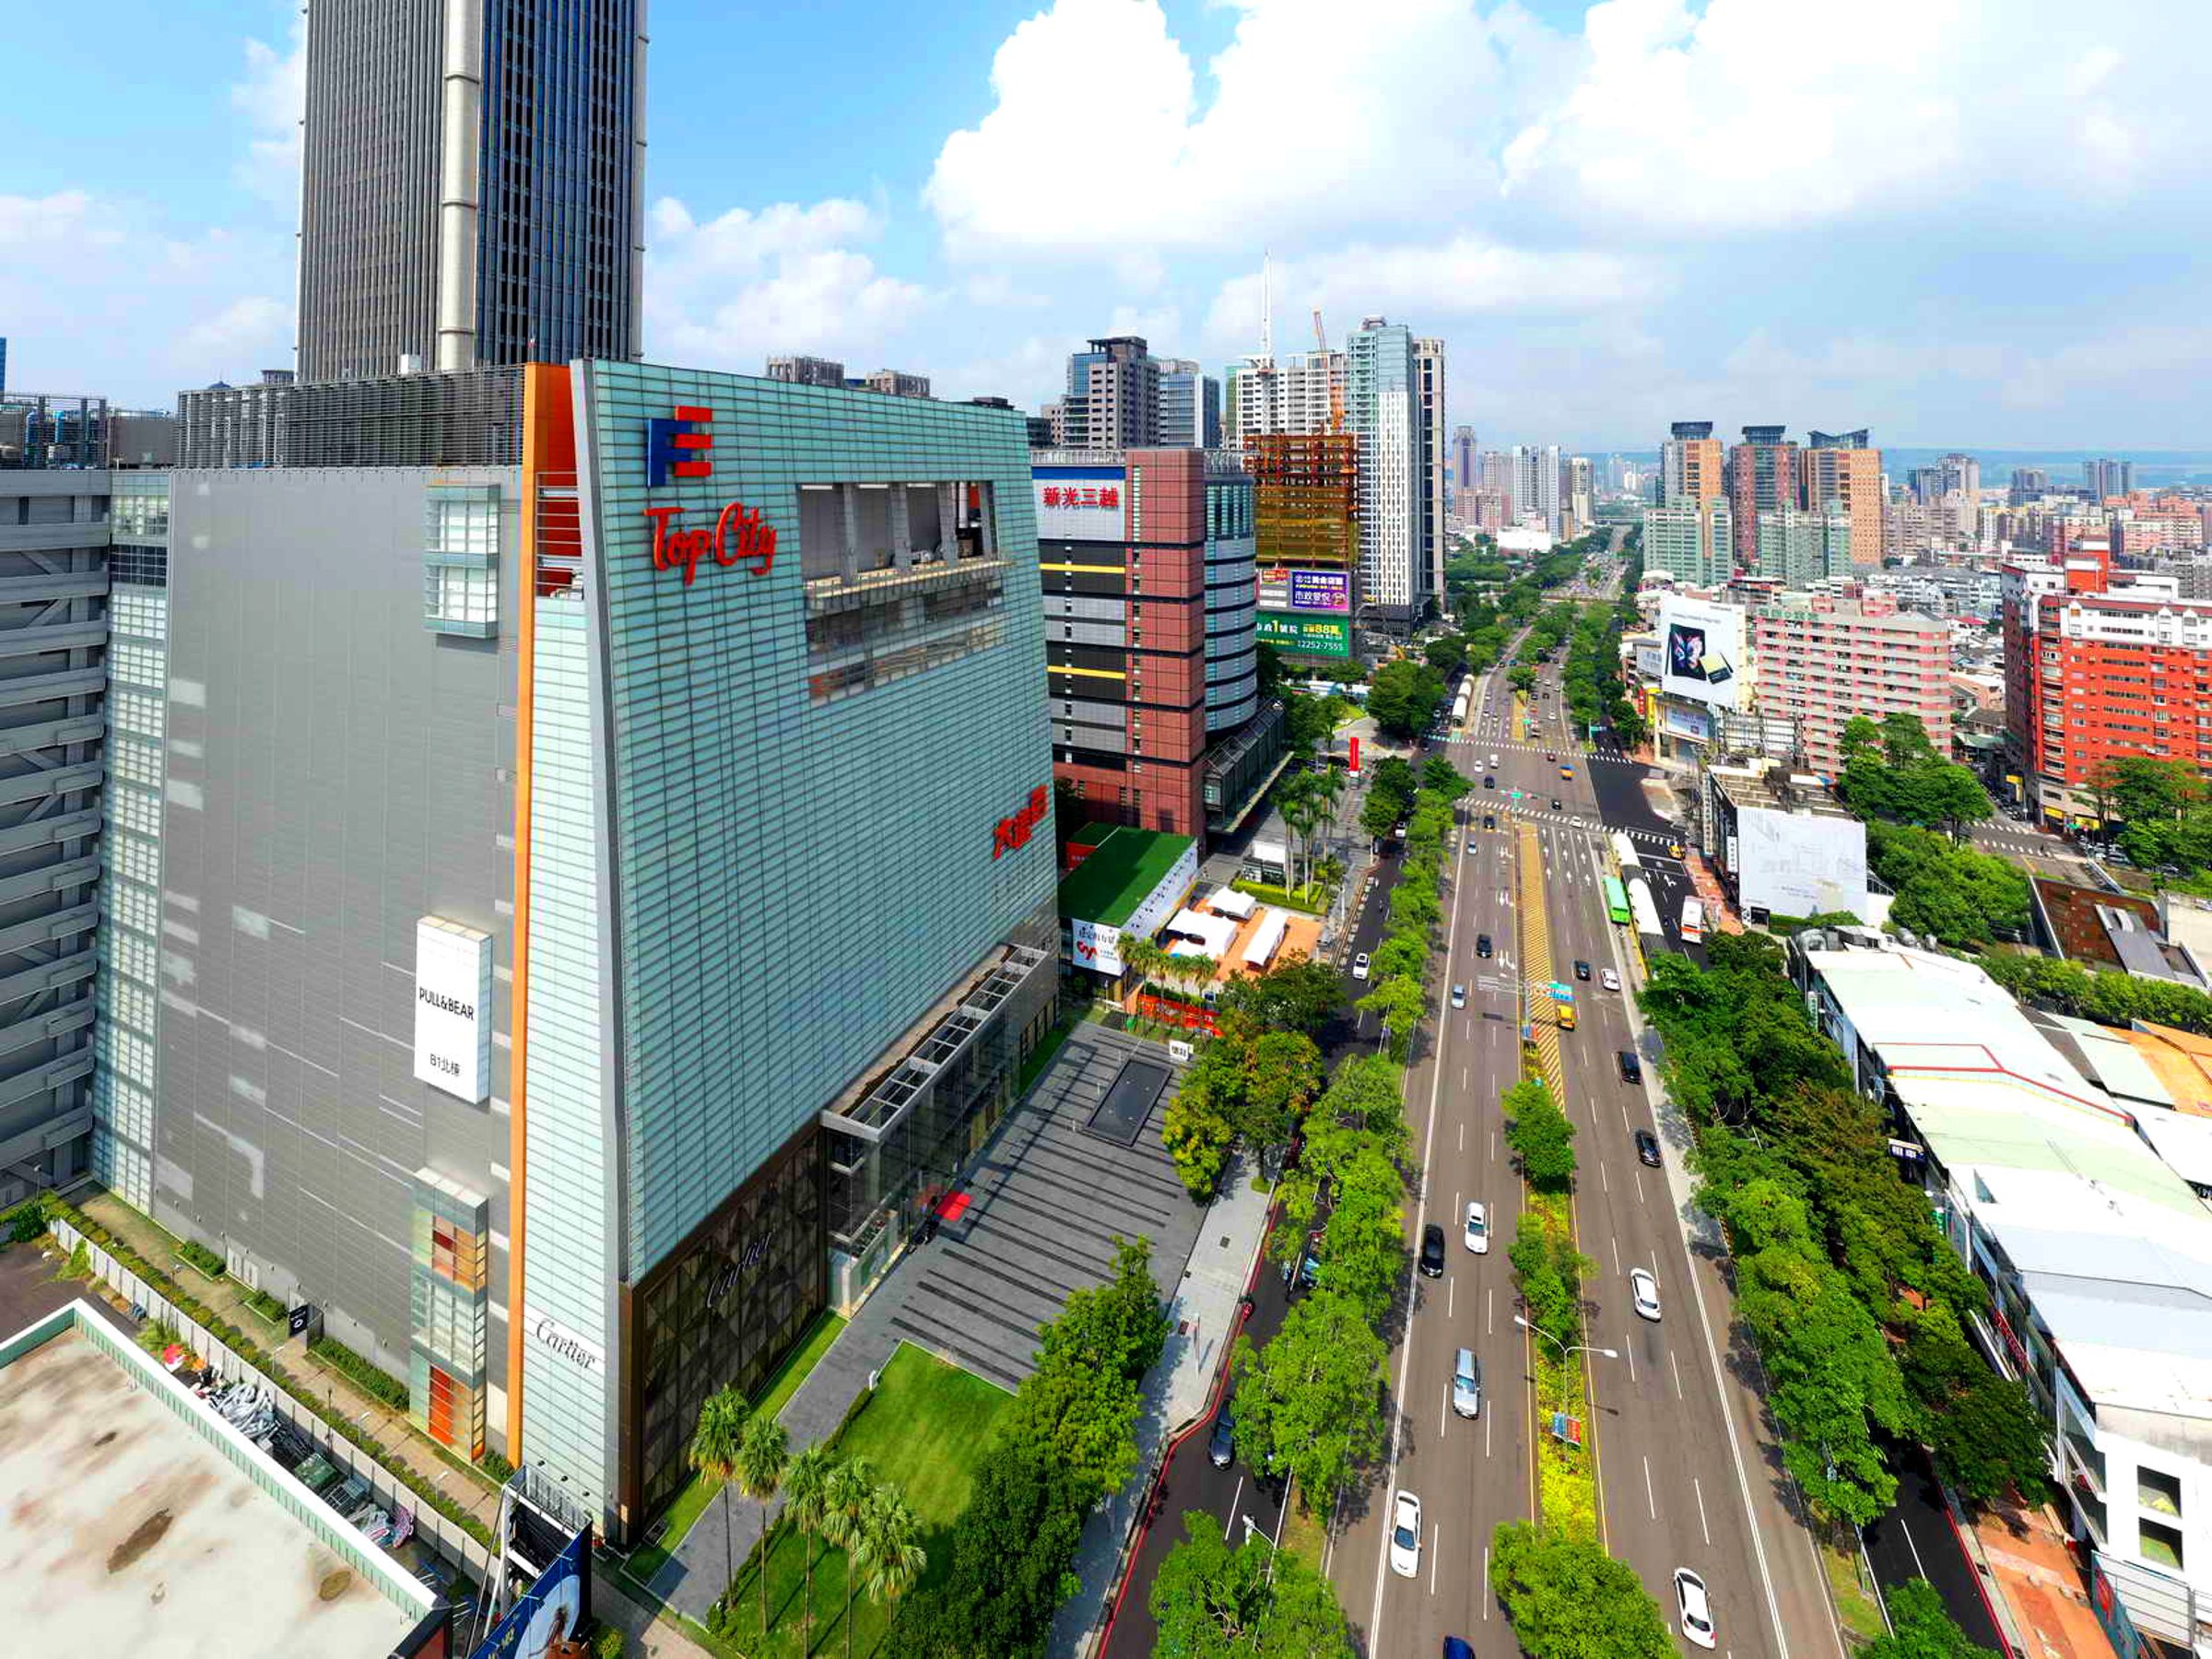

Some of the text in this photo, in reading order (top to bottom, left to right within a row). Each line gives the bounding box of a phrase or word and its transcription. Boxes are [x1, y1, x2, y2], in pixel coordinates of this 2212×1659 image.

[1043, 486, 1119, 509] 新光三越
[643, 500, 777, 587] Top City
[419, 986, 475, 1021] PULL&BEAR
[536, 1318, 596, 1370] Cartier
